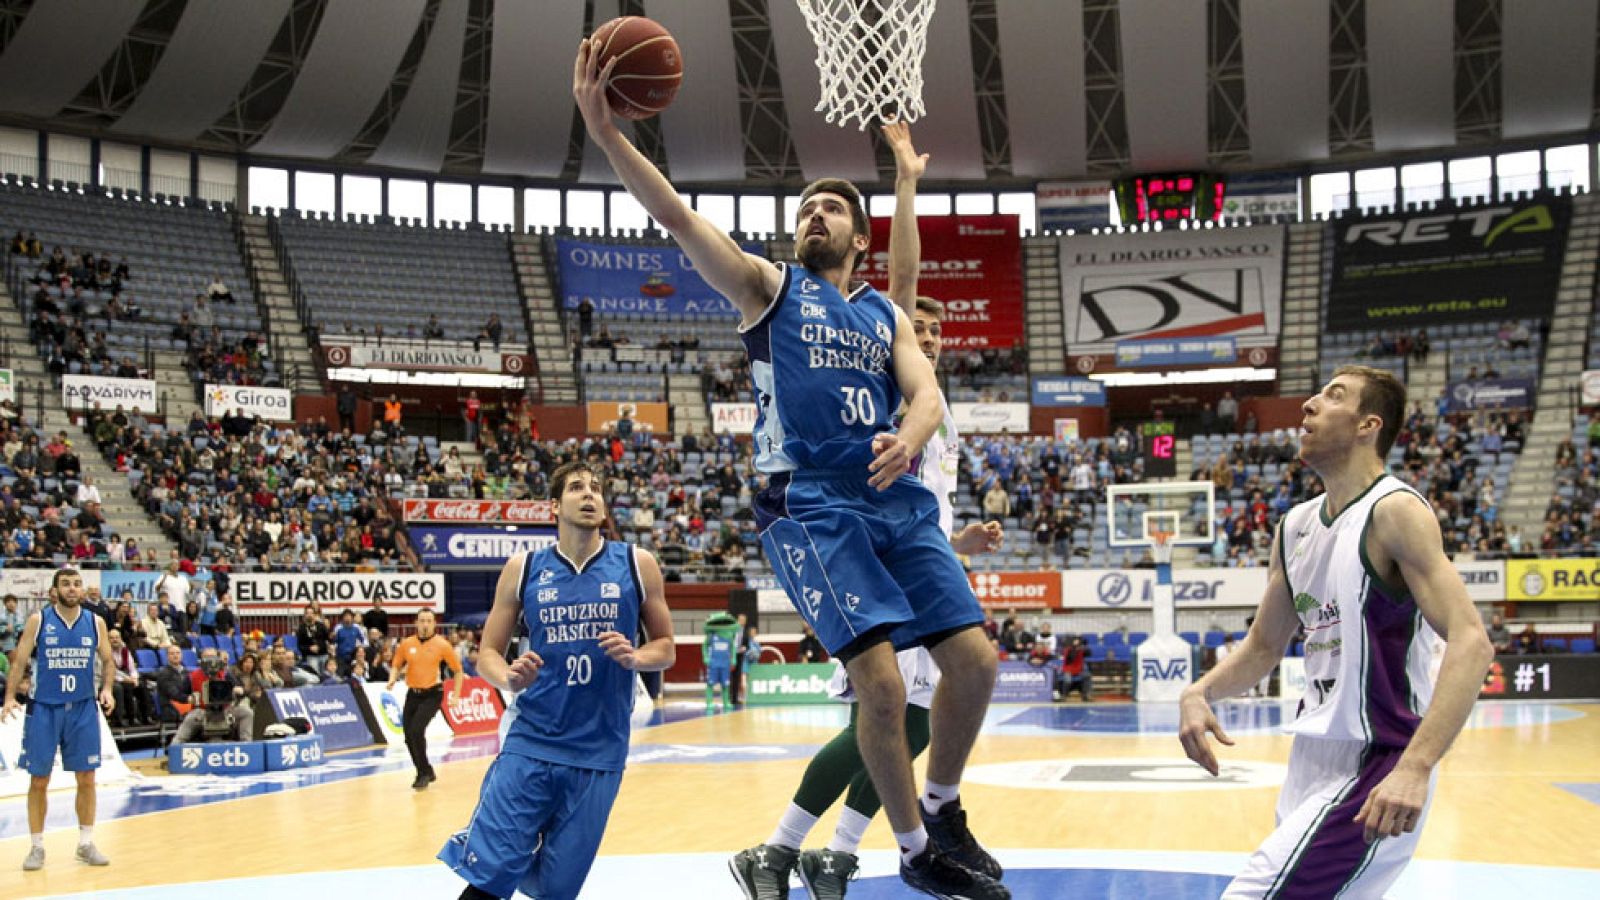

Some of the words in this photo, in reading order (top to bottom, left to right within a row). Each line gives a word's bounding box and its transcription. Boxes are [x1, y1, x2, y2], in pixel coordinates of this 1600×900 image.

[1345, 205, 1554, 247] RETA
[570, 247, 664, 271] OMNES
[1075, 253, 1098, 264] EL
[1111, 248, 1190, 263] DIARIO
[1199, 243, 1270, 257] VASCO
[1080, 268, 1244, 342] DV
[1366, 297, 1508, 318] www.reta.eu
[371, 350, 387, 363] EL
[391, 350, 439, 365] DIARIO
[442, 352, 482, 366] VASCO
[234, 389, 288, 408] Giroa
[840, 386, 876, 426] 30
[1153, 435, 1173, 458] 12
[434, 500, 480, 519] Coca-Cola
[236, 581, 265, 600] EL
[269, 580, 354, 601] DIARIO
[359, 579, 436, 601] VASCO
[1142, 579, 1225, 601] Izar
[539, 603, 618, 624] GIPUZKOA
[546, 621, 615, 644] BASKET
[48, 658, 89, 669] BASKET
[566, 655, 592, 687] 20
[1142, 658, 1187, 680] AVK
[59, 674, 76, 692] 10
[1514, 662, 1551, 692] #1
[207, 746, 250, 767] etb
[301, 743, 321, 762] etb
